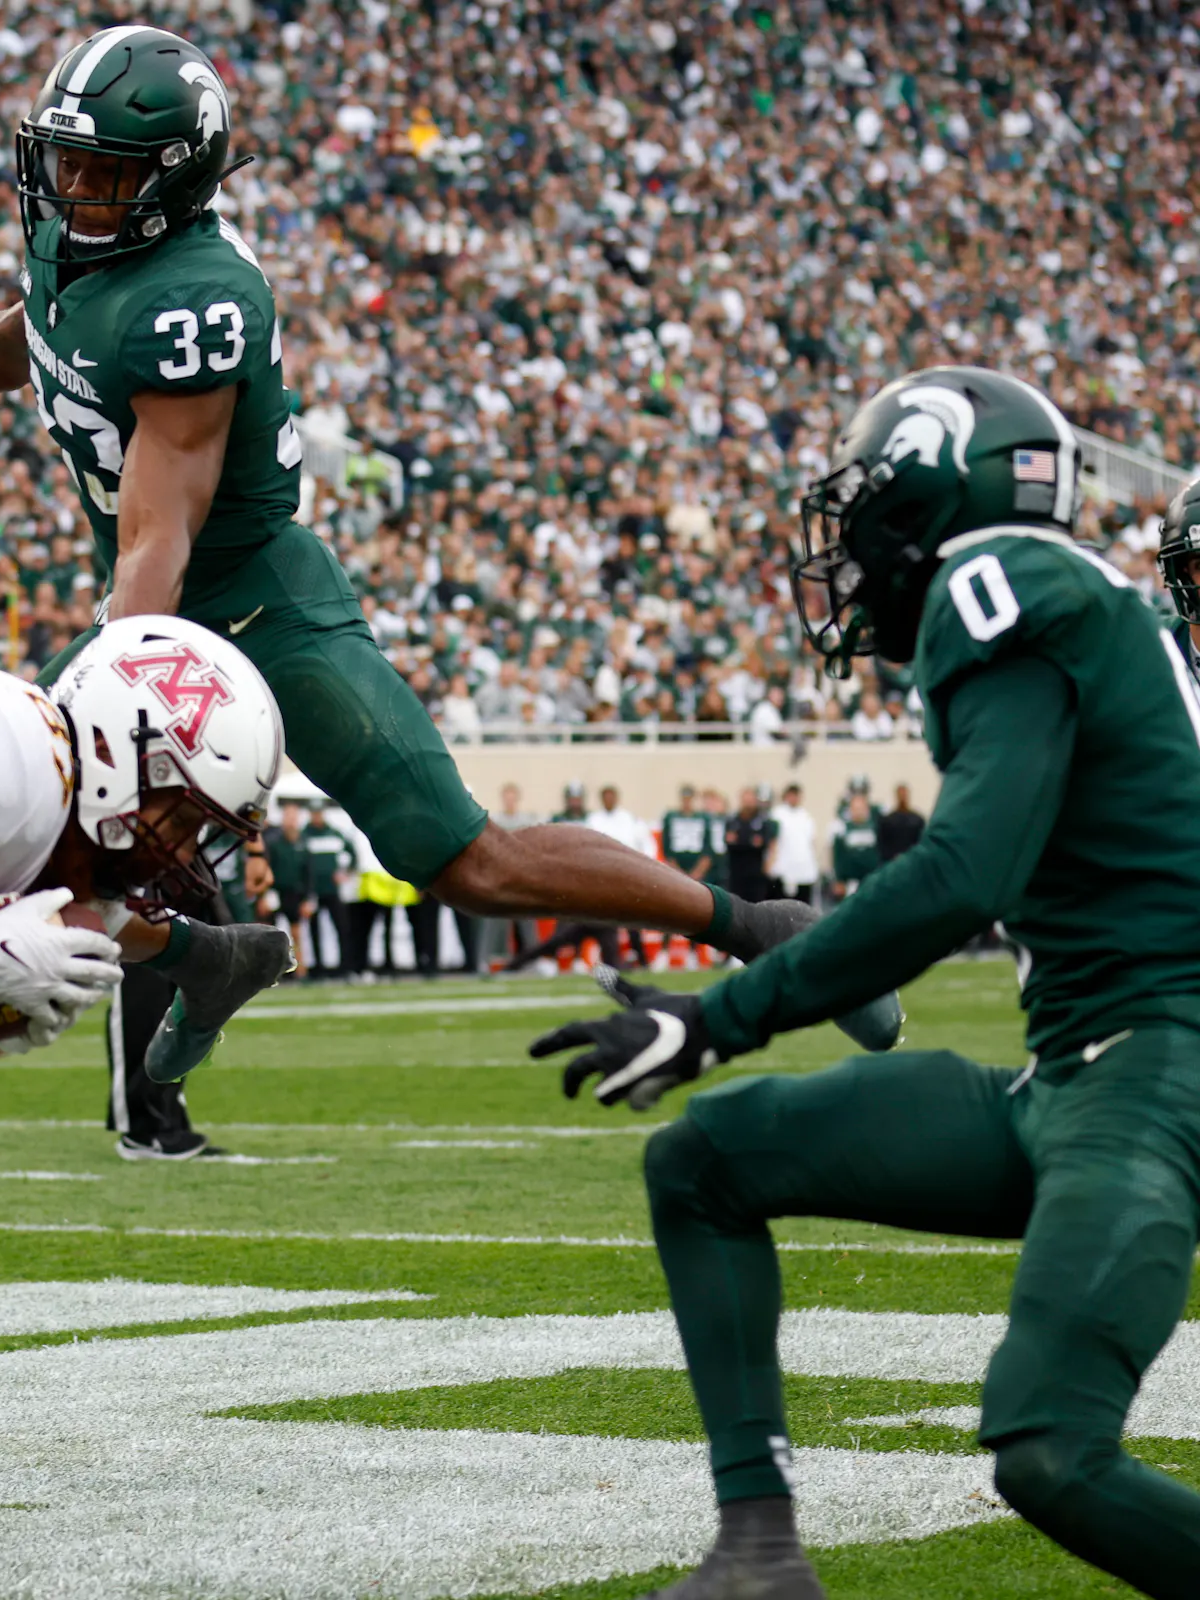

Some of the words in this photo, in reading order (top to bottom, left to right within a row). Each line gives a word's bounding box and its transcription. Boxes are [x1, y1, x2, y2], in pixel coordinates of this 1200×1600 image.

[50, 112, 79, 129] STATE
[153, 301, 247, 381] 33
[57, 358, 104, 405] STATE
[949, 554, 1020, 642] 0
[112, 644, 235, 759] M
